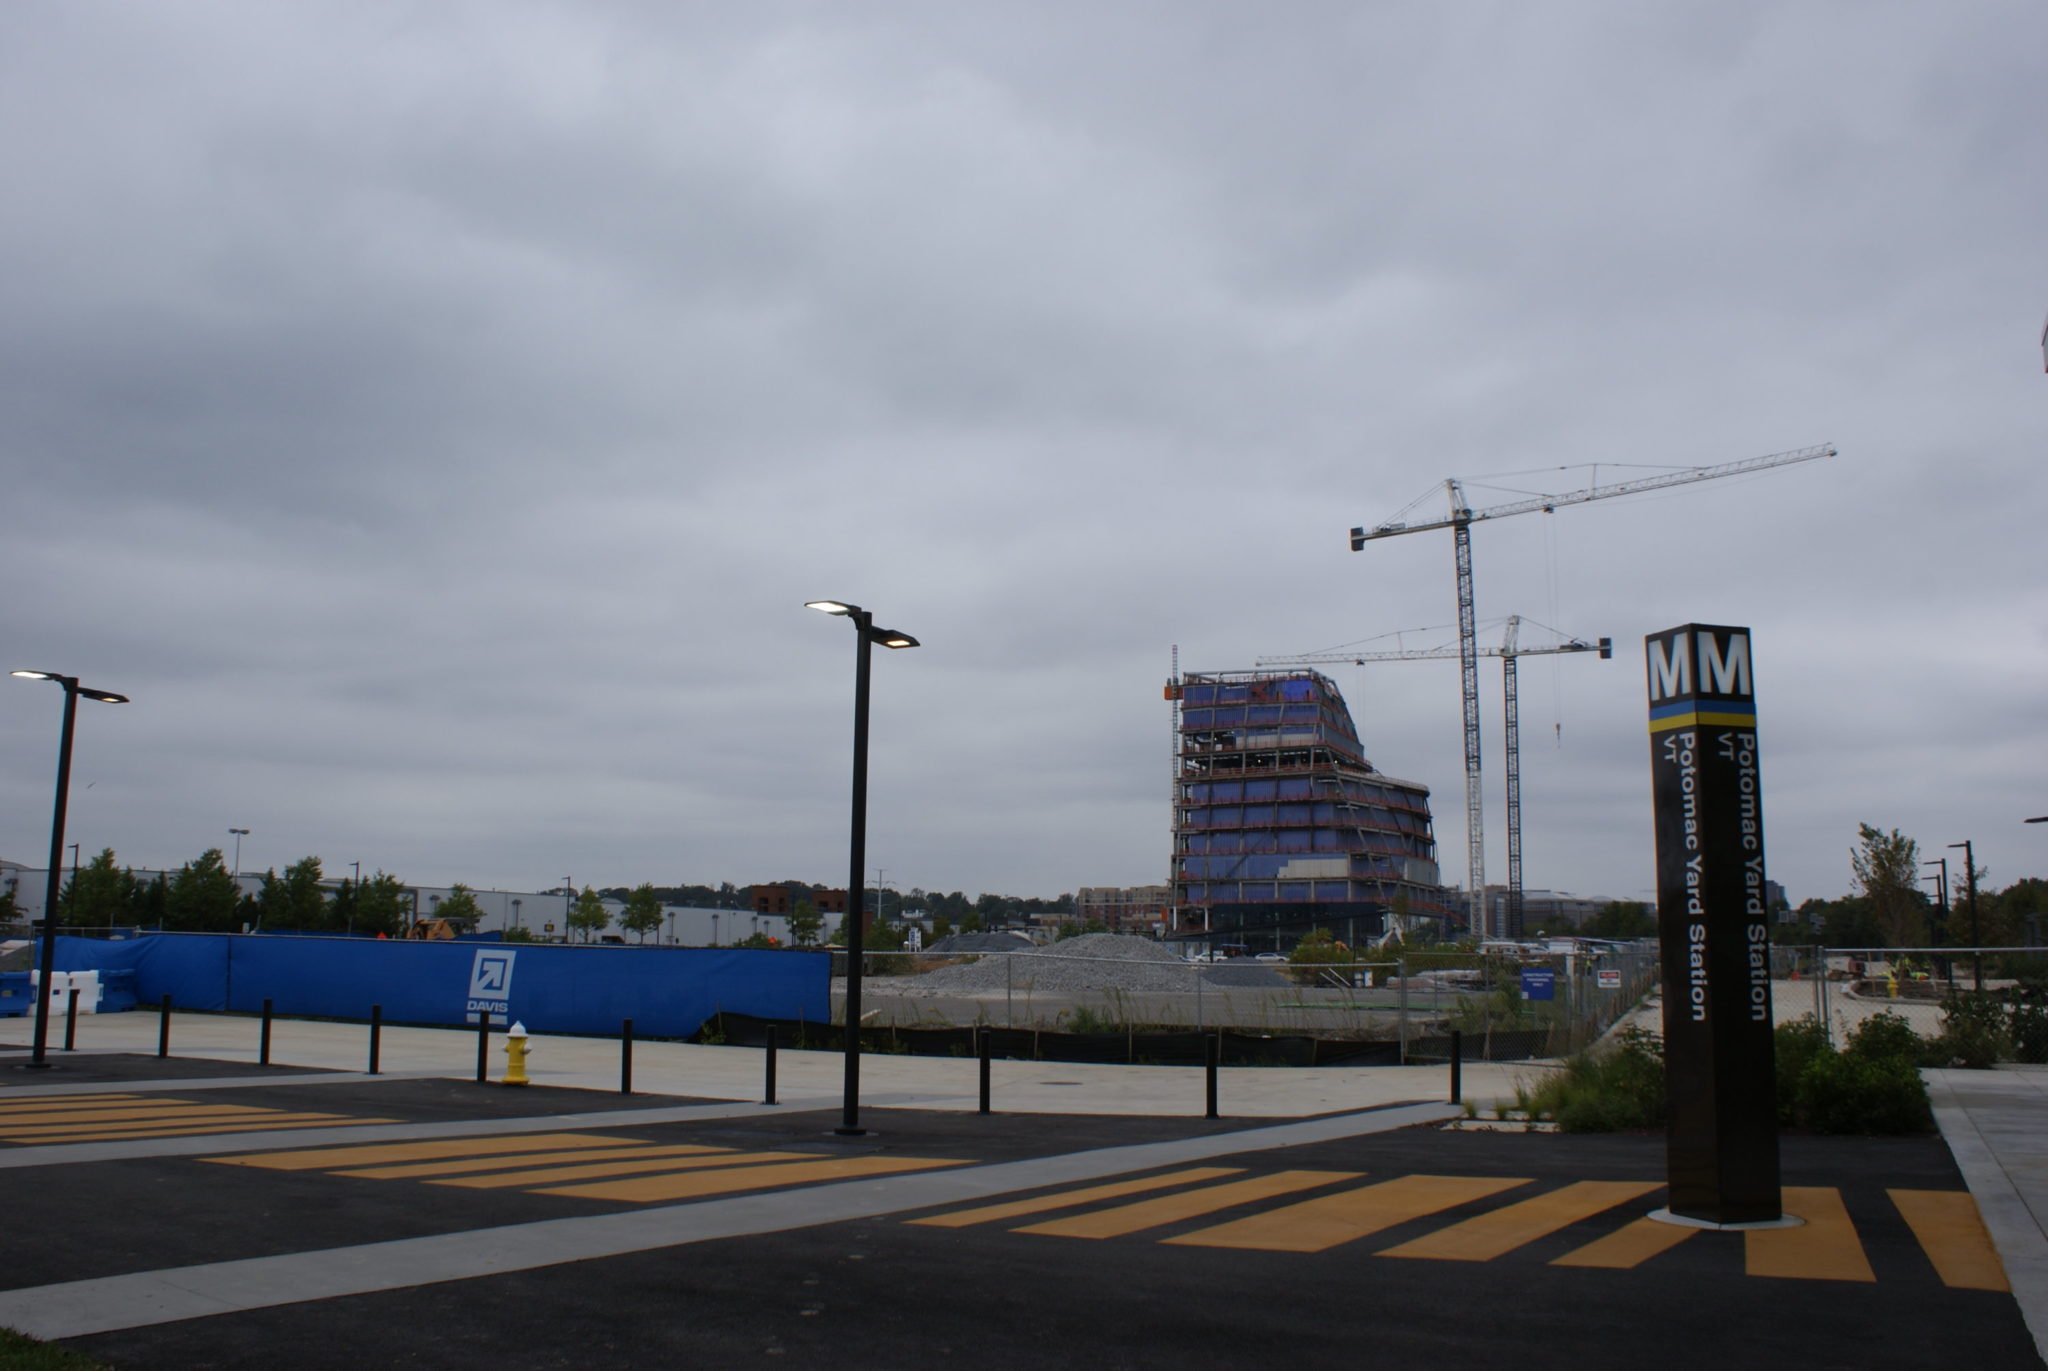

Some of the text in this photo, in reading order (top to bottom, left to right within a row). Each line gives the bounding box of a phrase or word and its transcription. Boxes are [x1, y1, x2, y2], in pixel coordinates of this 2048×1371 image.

[1648, 632, 1692, 702] M
[1697, 631, 1752, 696] M
[1663, 734, 1677, 763] VT
[1718, 732, 1734, 761] VT
[1679, 732, 1708, 1021] Potomac Yard Station
[1737, 733, 1769, 1021] Potomac Yard Station
[466, 1000, 509, 1013] DAVIS
